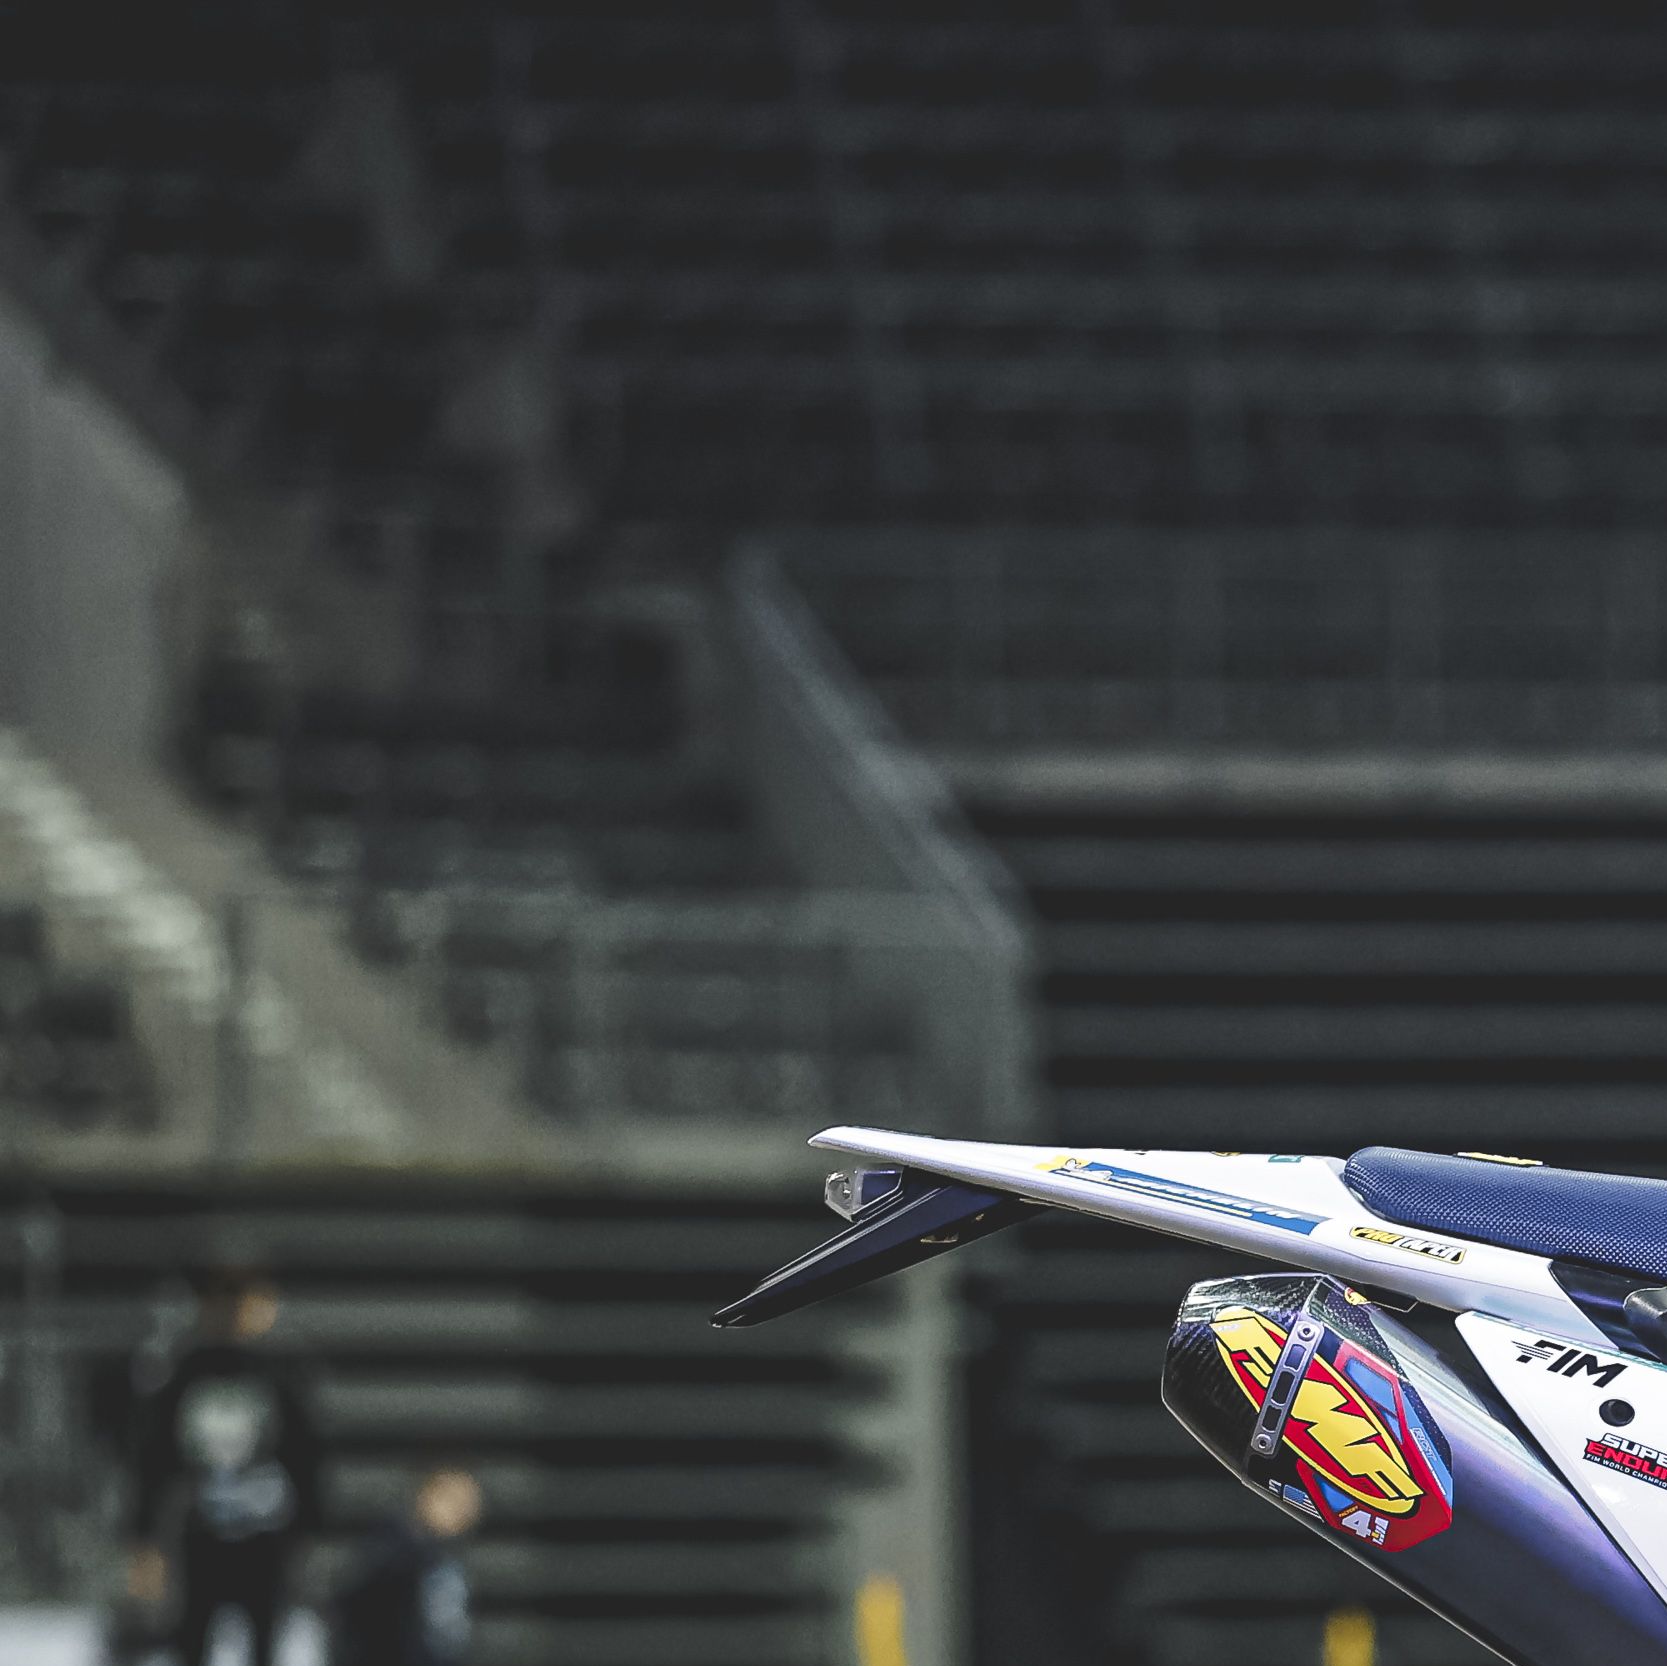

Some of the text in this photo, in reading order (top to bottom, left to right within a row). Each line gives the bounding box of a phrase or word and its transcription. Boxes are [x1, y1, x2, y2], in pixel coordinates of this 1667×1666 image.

[1511, 1339, 1629, 1388] FIM
[1209, 1316, 1425, 1500] FMF
[1586, 1453, 1601, 1464] FIM
[1602, 1459, 1631, 1474] WORLD
